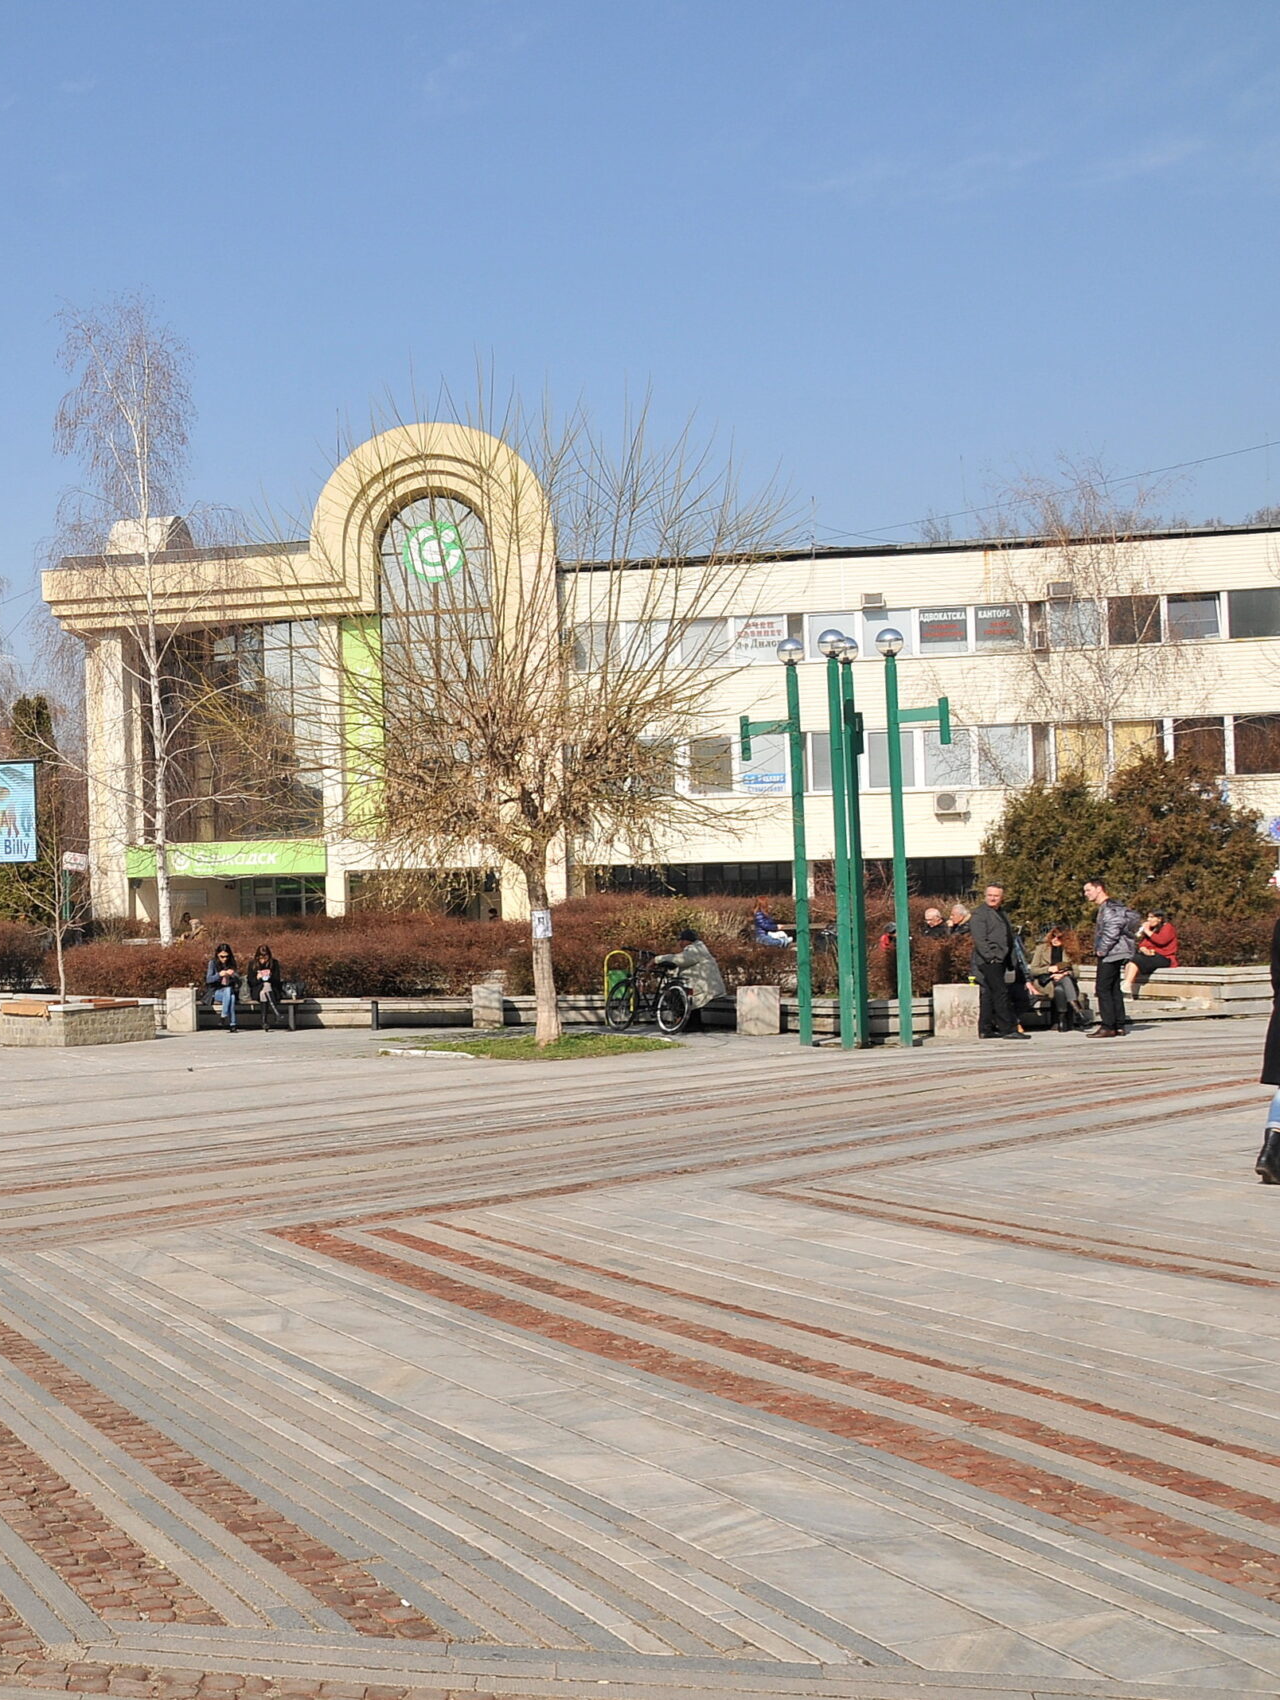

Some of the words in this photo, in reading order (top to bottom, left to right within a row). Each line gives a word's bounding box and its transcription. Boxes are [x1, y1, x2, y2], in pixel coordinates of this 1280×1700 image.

[920, 611, 966, 622] АДВОКАТСКА
[977, 609, 1011, 619] КАНТОРА
[4, 838, 30, 859] Billy
